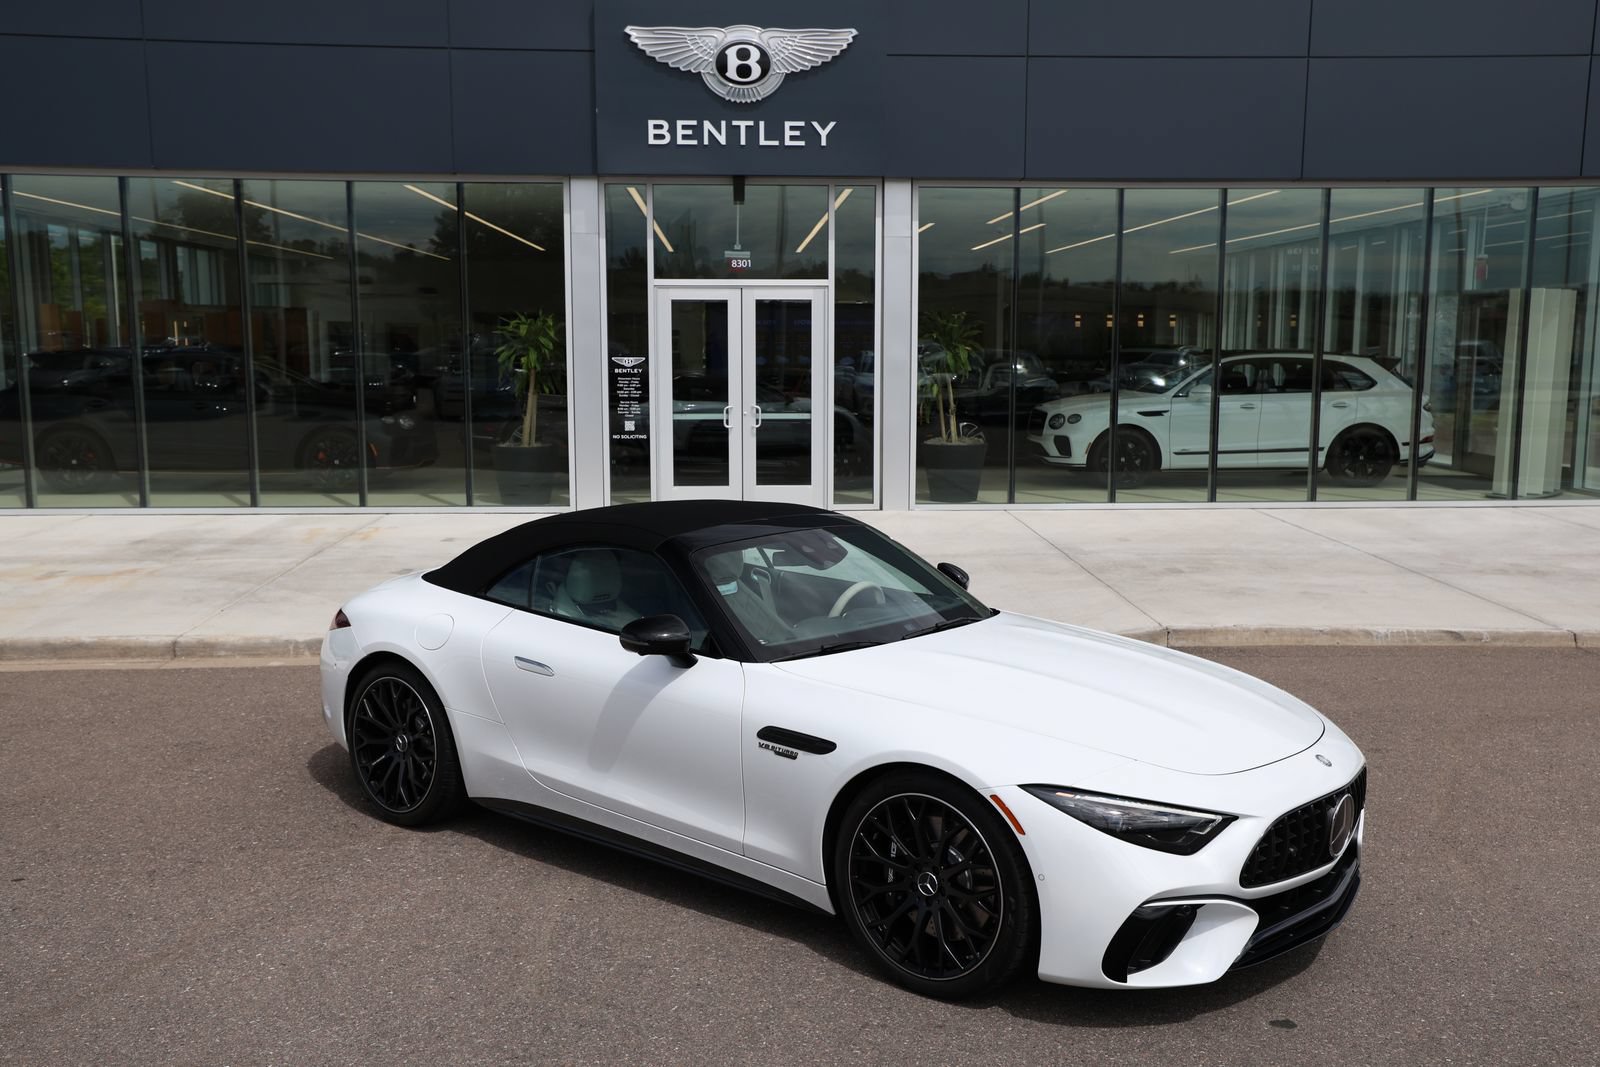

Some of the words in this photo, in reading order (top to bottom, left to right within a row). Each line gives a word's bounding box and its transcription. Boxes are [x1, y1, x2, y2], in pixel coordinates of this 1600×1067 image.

[725, 44, 762, 83] B
[647, 120, 837, 147] BENTLEY
[731, 260, 751, 268] 8301
